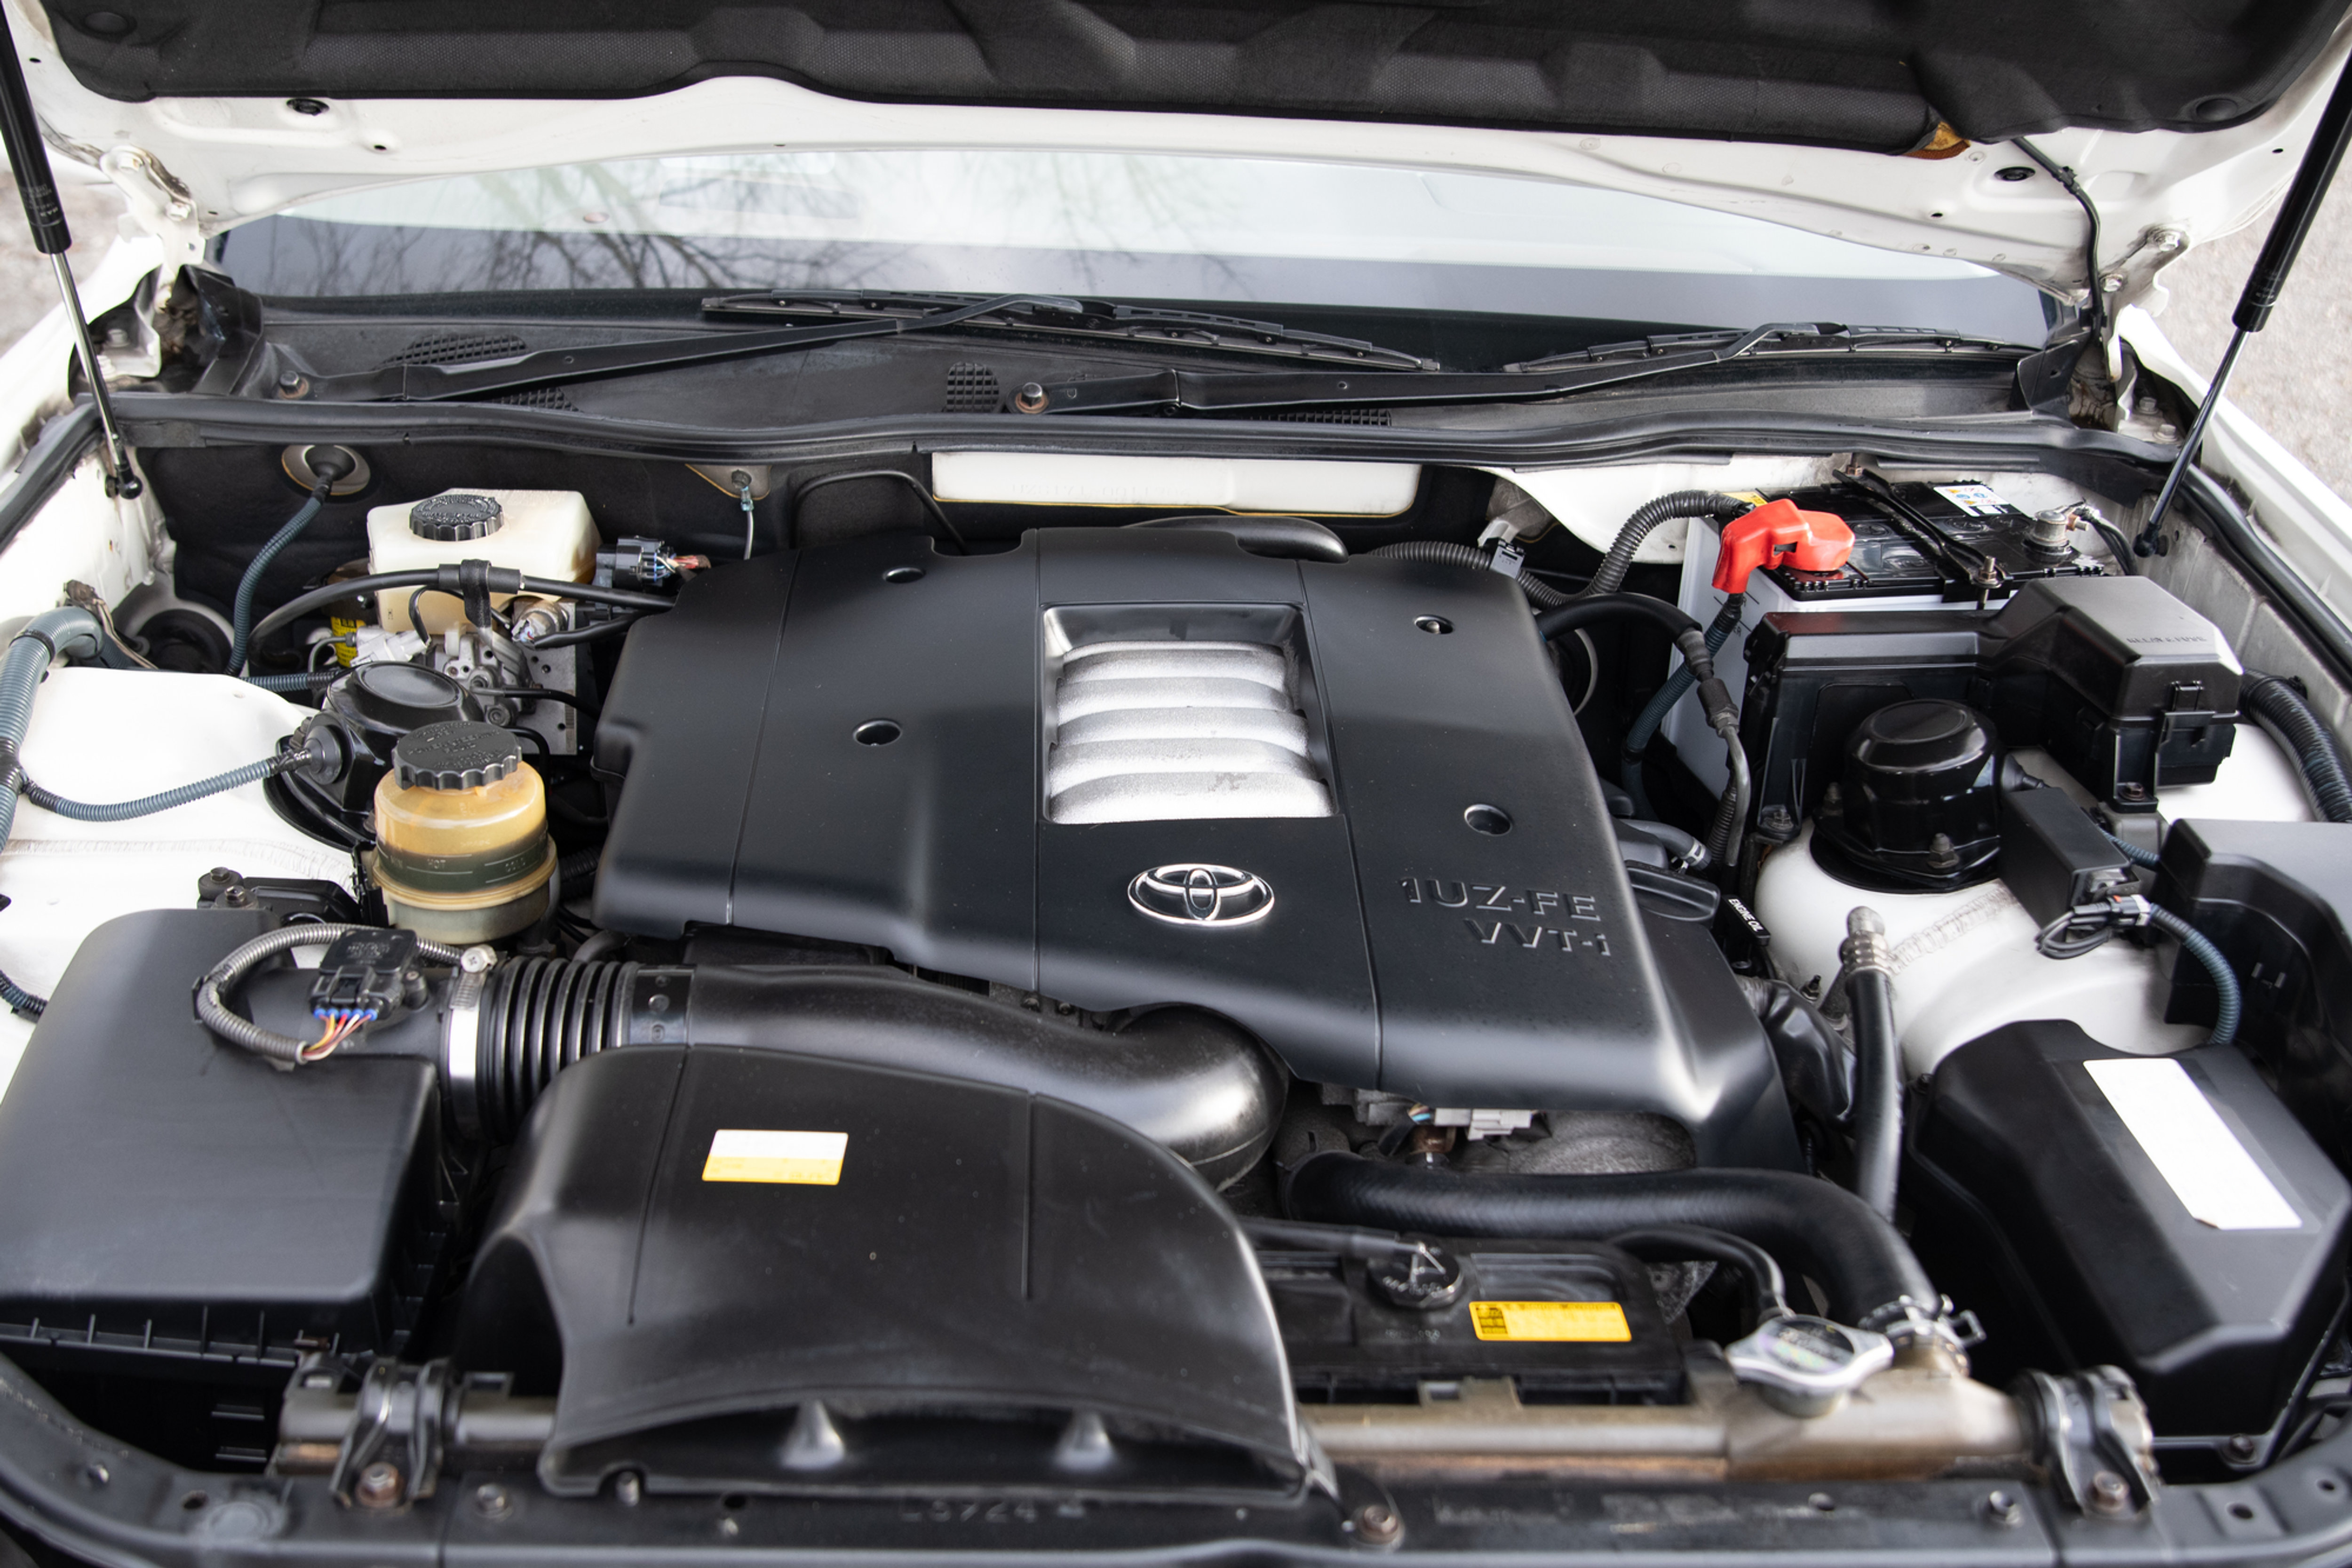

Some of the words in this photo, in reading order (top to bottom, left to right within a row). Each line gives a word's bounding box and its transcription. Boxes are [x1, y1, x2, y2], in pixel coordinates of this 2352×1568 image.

[1400, 877, 1600, 922] 1UZ-FE
[1728, 898, 1756, 921] ENGINE
[1748, 921, 1764, 932] OIL
